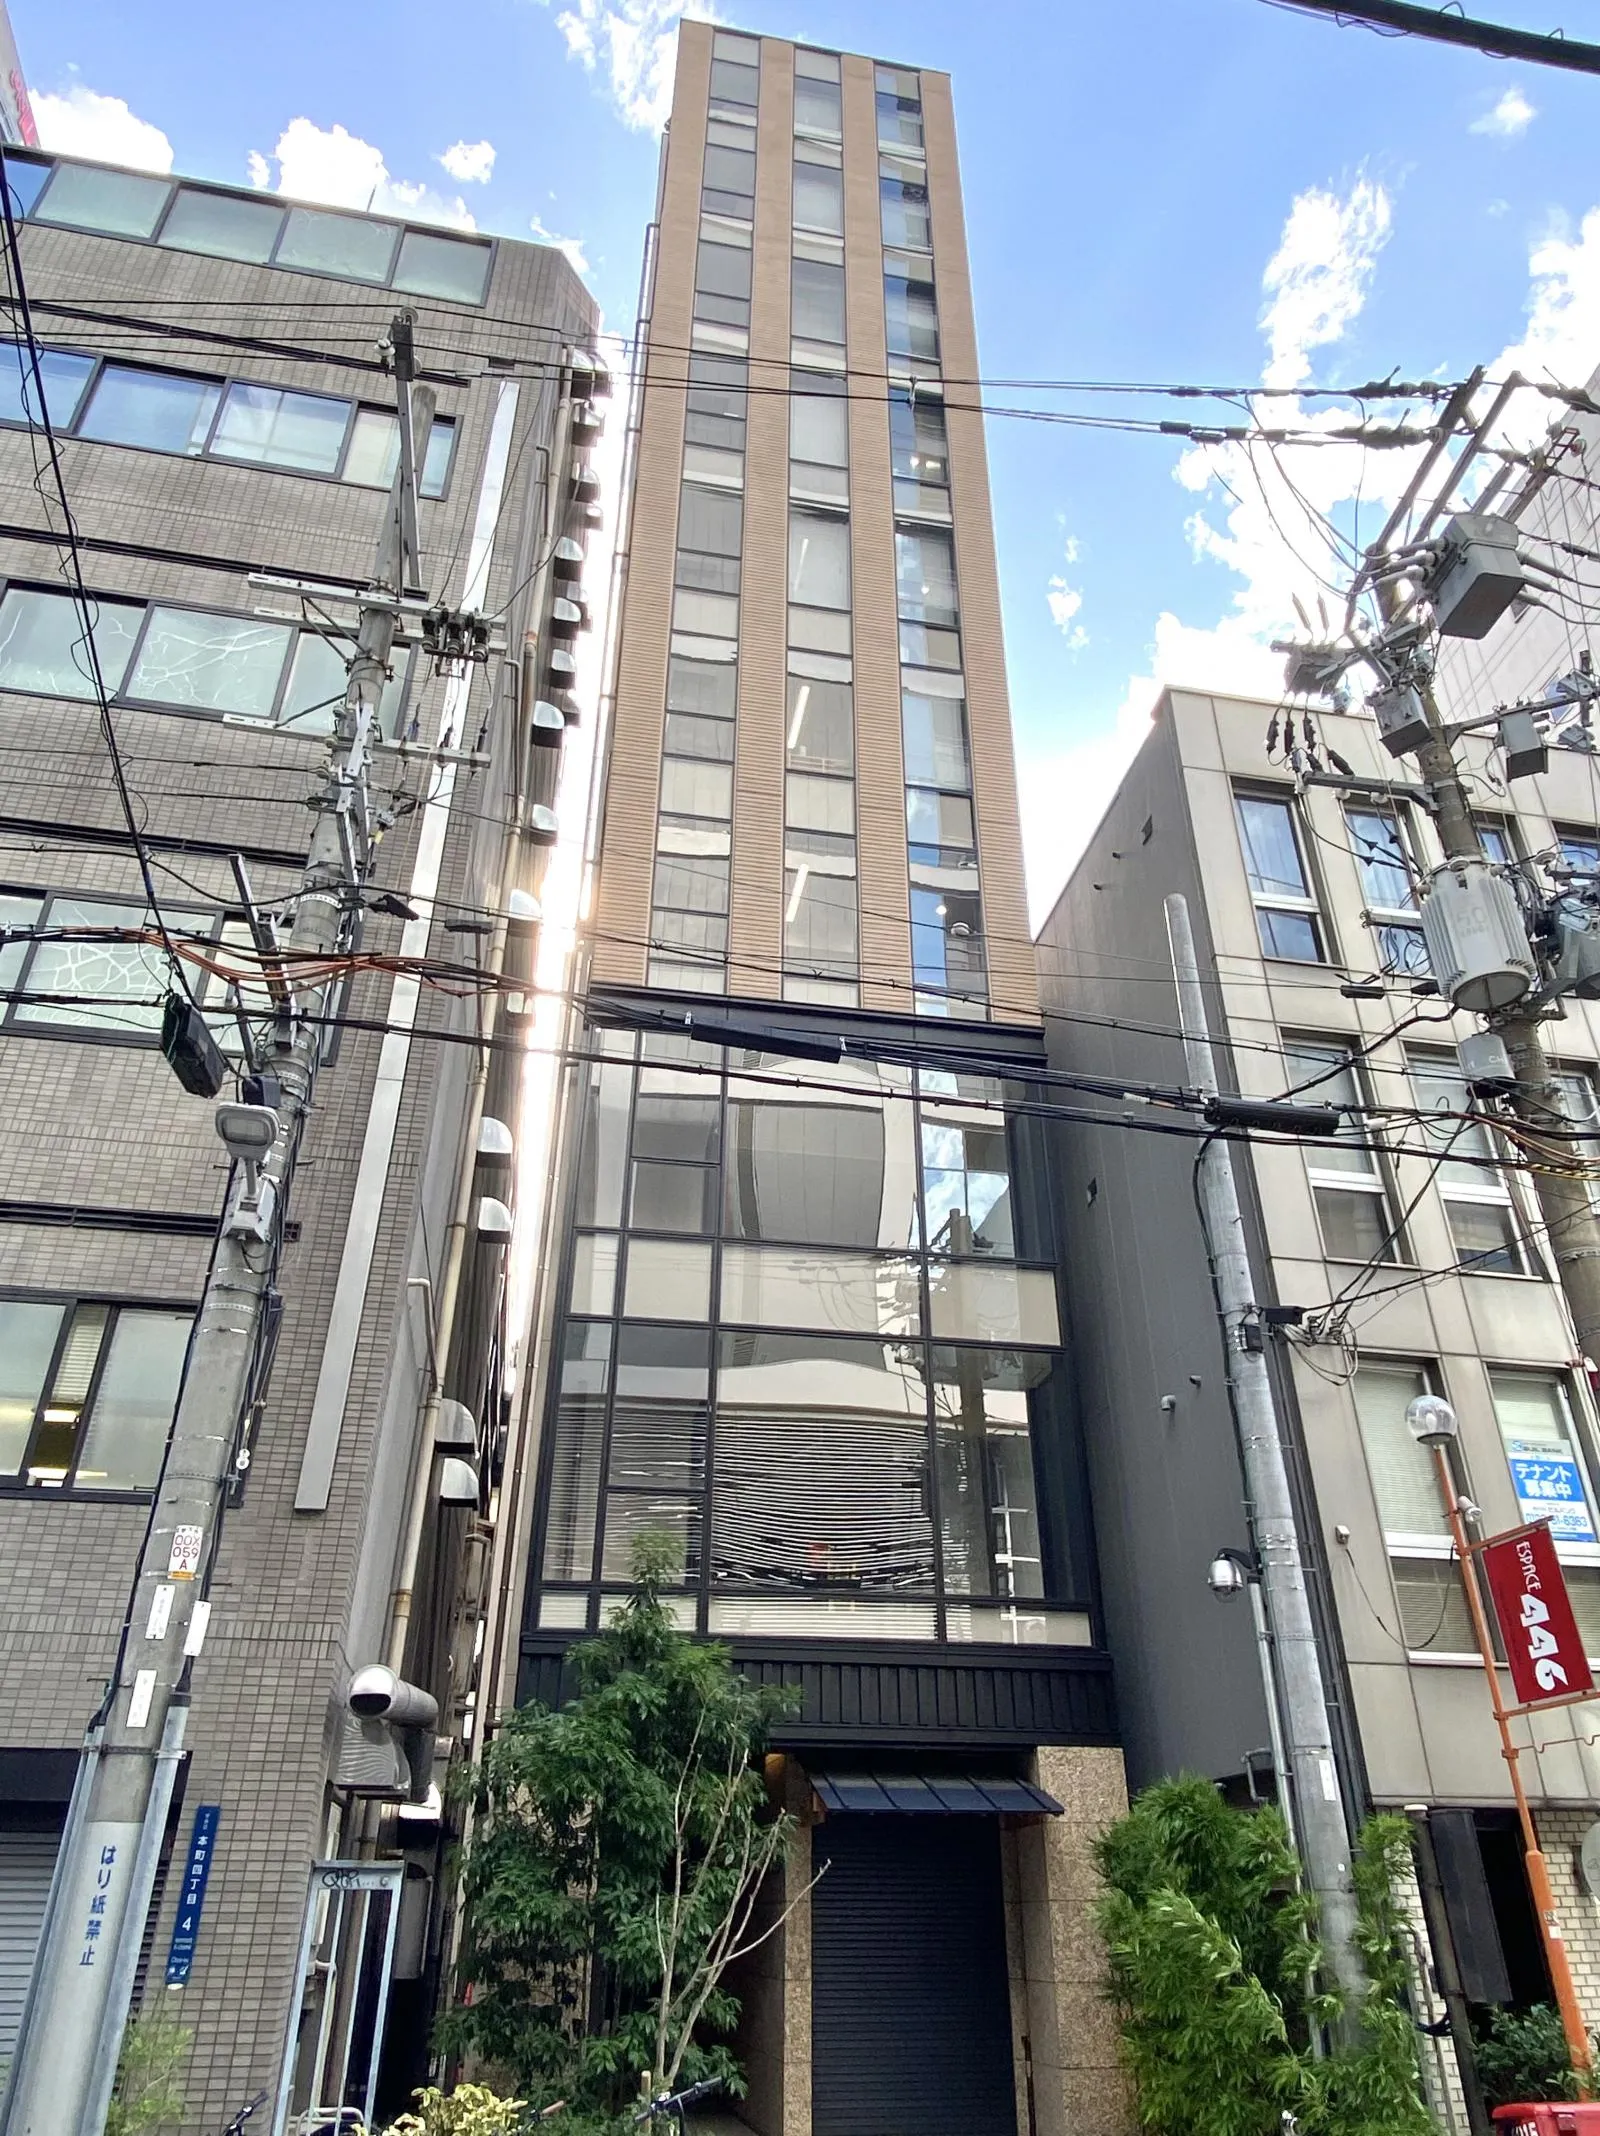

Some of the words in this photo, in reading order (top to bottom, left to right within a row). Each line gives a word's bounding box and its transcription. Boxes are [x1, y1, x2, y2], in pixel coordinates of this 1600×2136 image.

[1515, 1463, 1572, 1482] テナント
[1523, 1479, 1573, 1499] 募集中
[173, 1547, 198, 1558] 059
[179, 1559, 188, 1570] A
[1516, 1541, 1542, 1593] ESPACE
[1519, 1593, 1569, 1690] 446
[186, 1836, 208, 1904] 本町四丁目
[79, 1845, 118, 1966] はり紙禁止
[181, 1916, 192, 1932] 4
